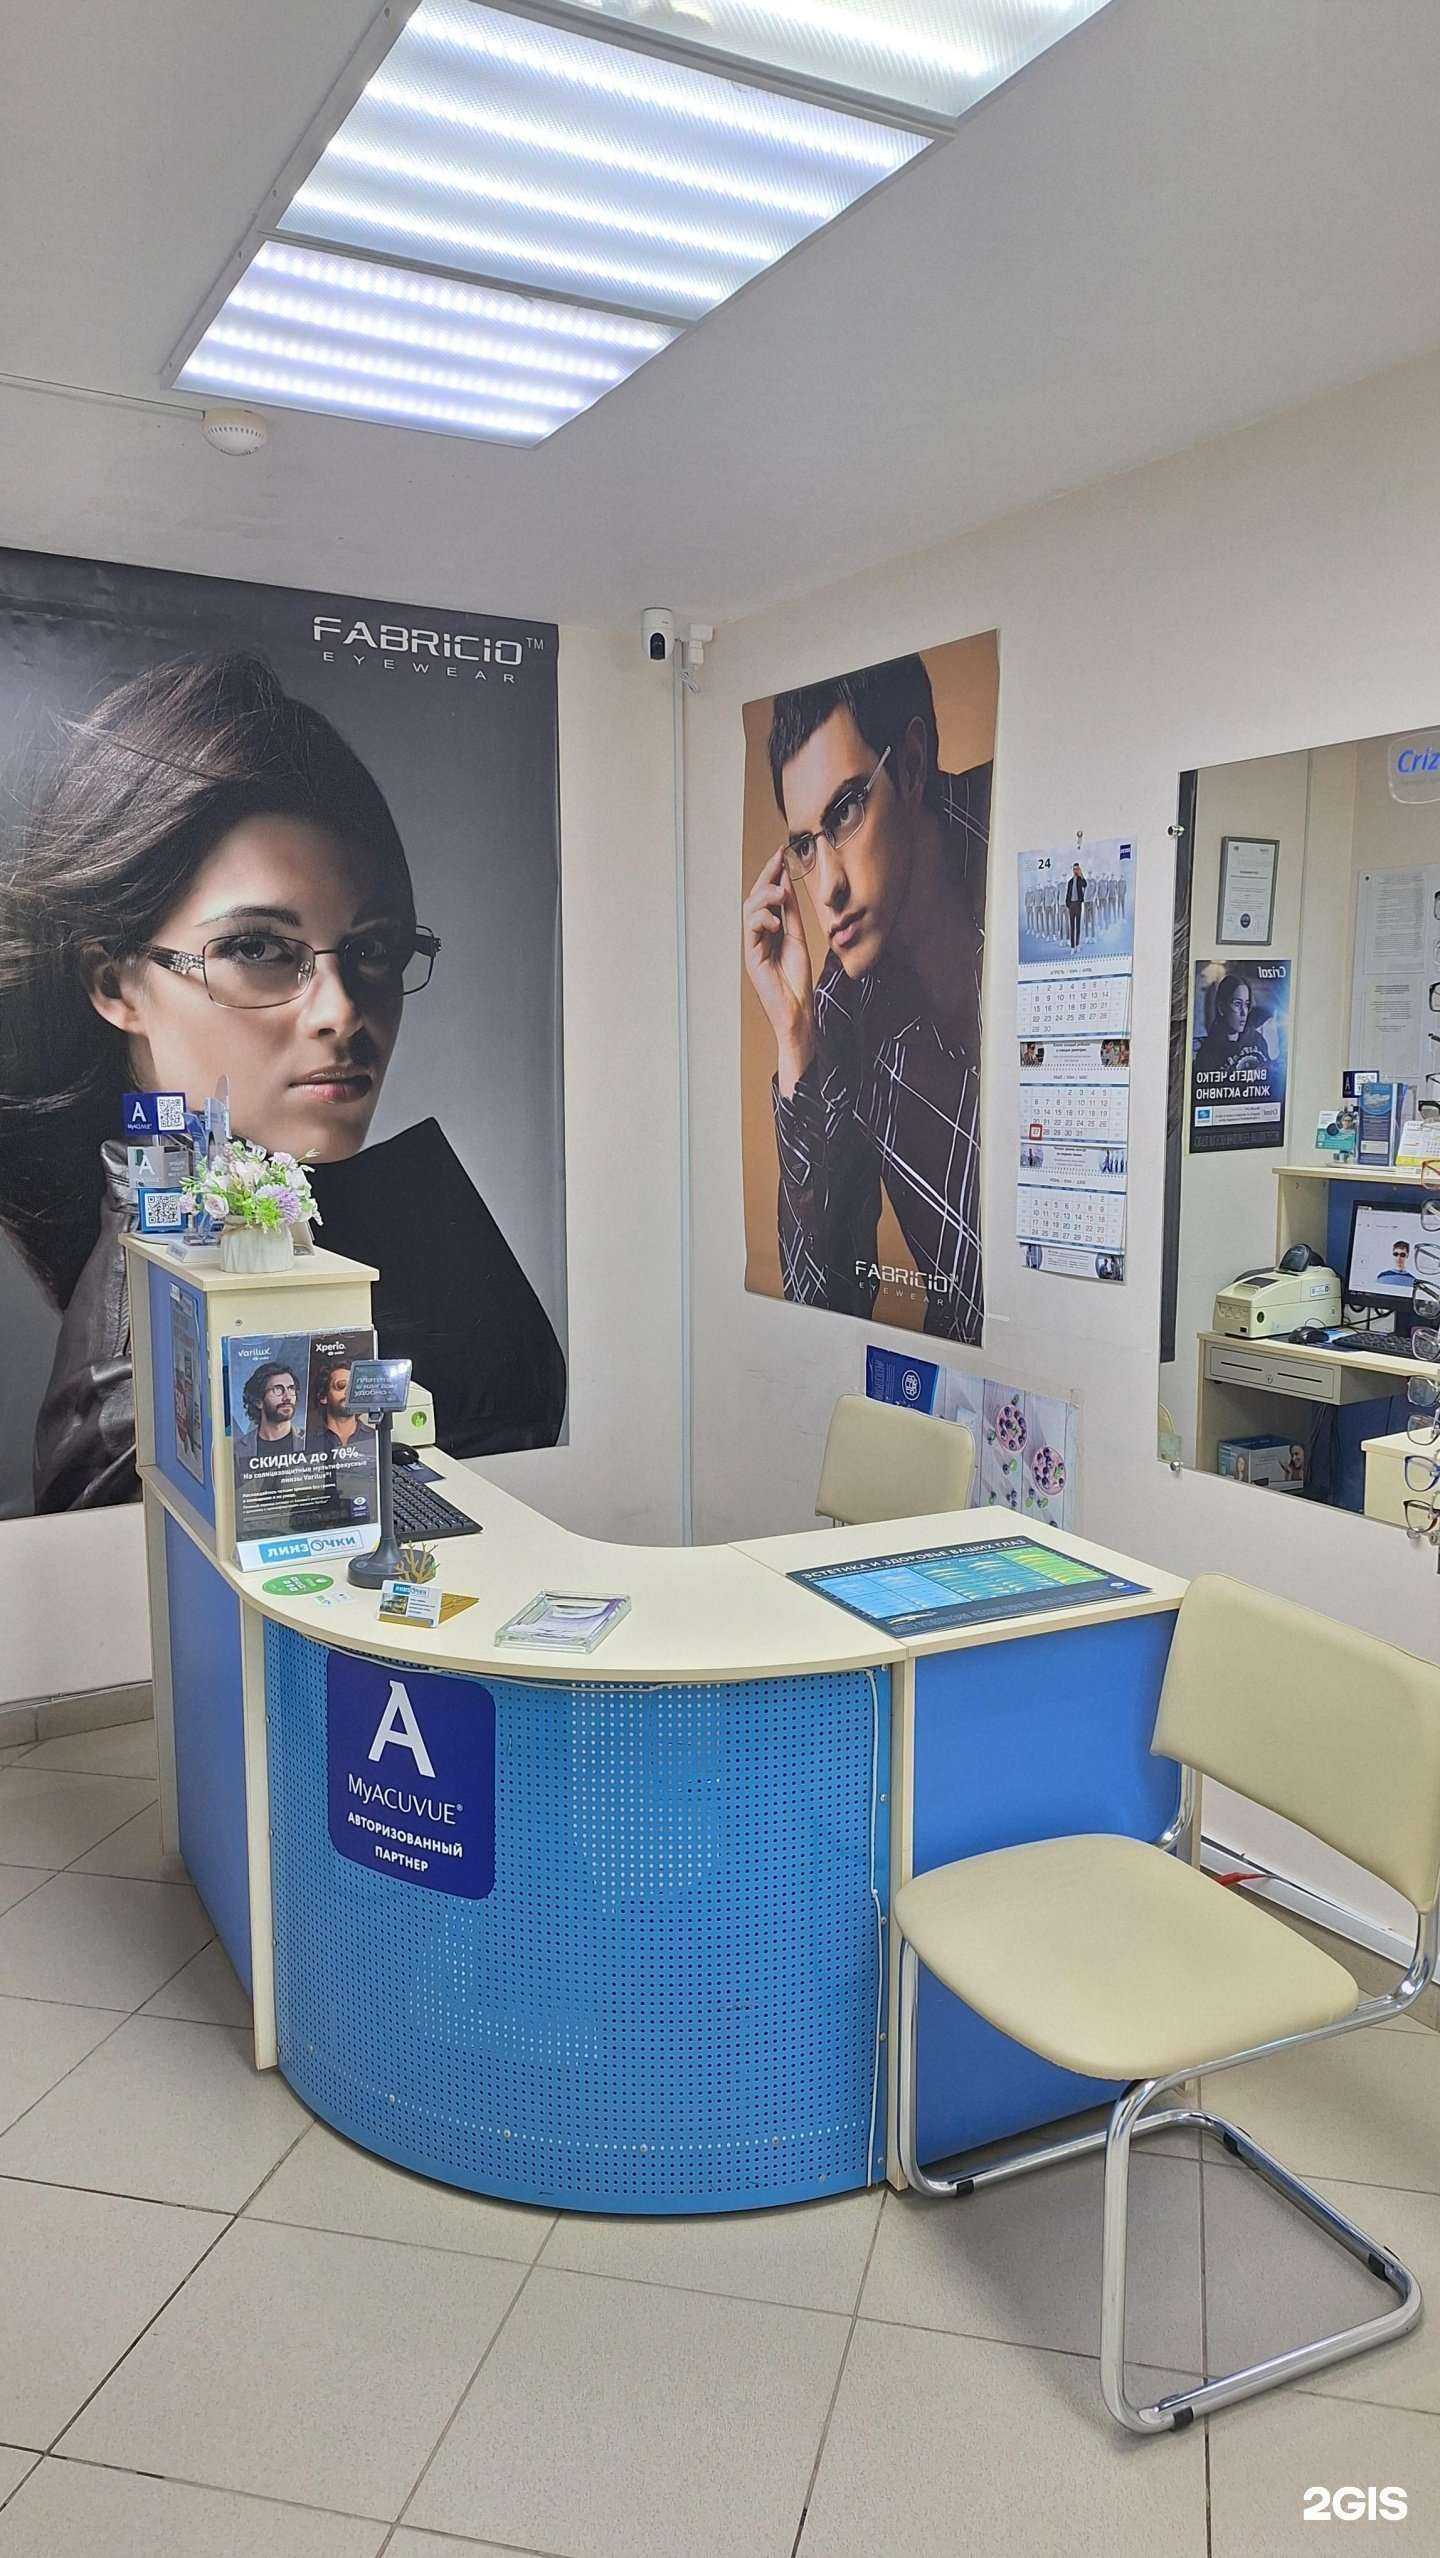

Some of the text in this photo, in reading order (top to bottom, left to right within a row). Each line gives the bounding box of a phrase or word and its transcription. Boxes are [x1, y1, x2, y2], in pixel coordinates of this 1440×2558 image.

[323, 651, 515, 684] EYEWEAR
[132, 1101, 147, 1122] A
[859, 1282, 944, 1306] EYEWEAR
[249, 1446, 359, 1470] СКИДКА до 70%
[801, 1539, 1027, 1580] ЭСТЕТИКА И ЗДОРОВЬЕ ВАШИХ ГЛАЗ
[368, 1679, 436, 1779] A
[347, 1811, 463, 1858] АВТОРИЗОВАННЫЙ
[375, 1845, 428, 1872] ПАРТНЕР
